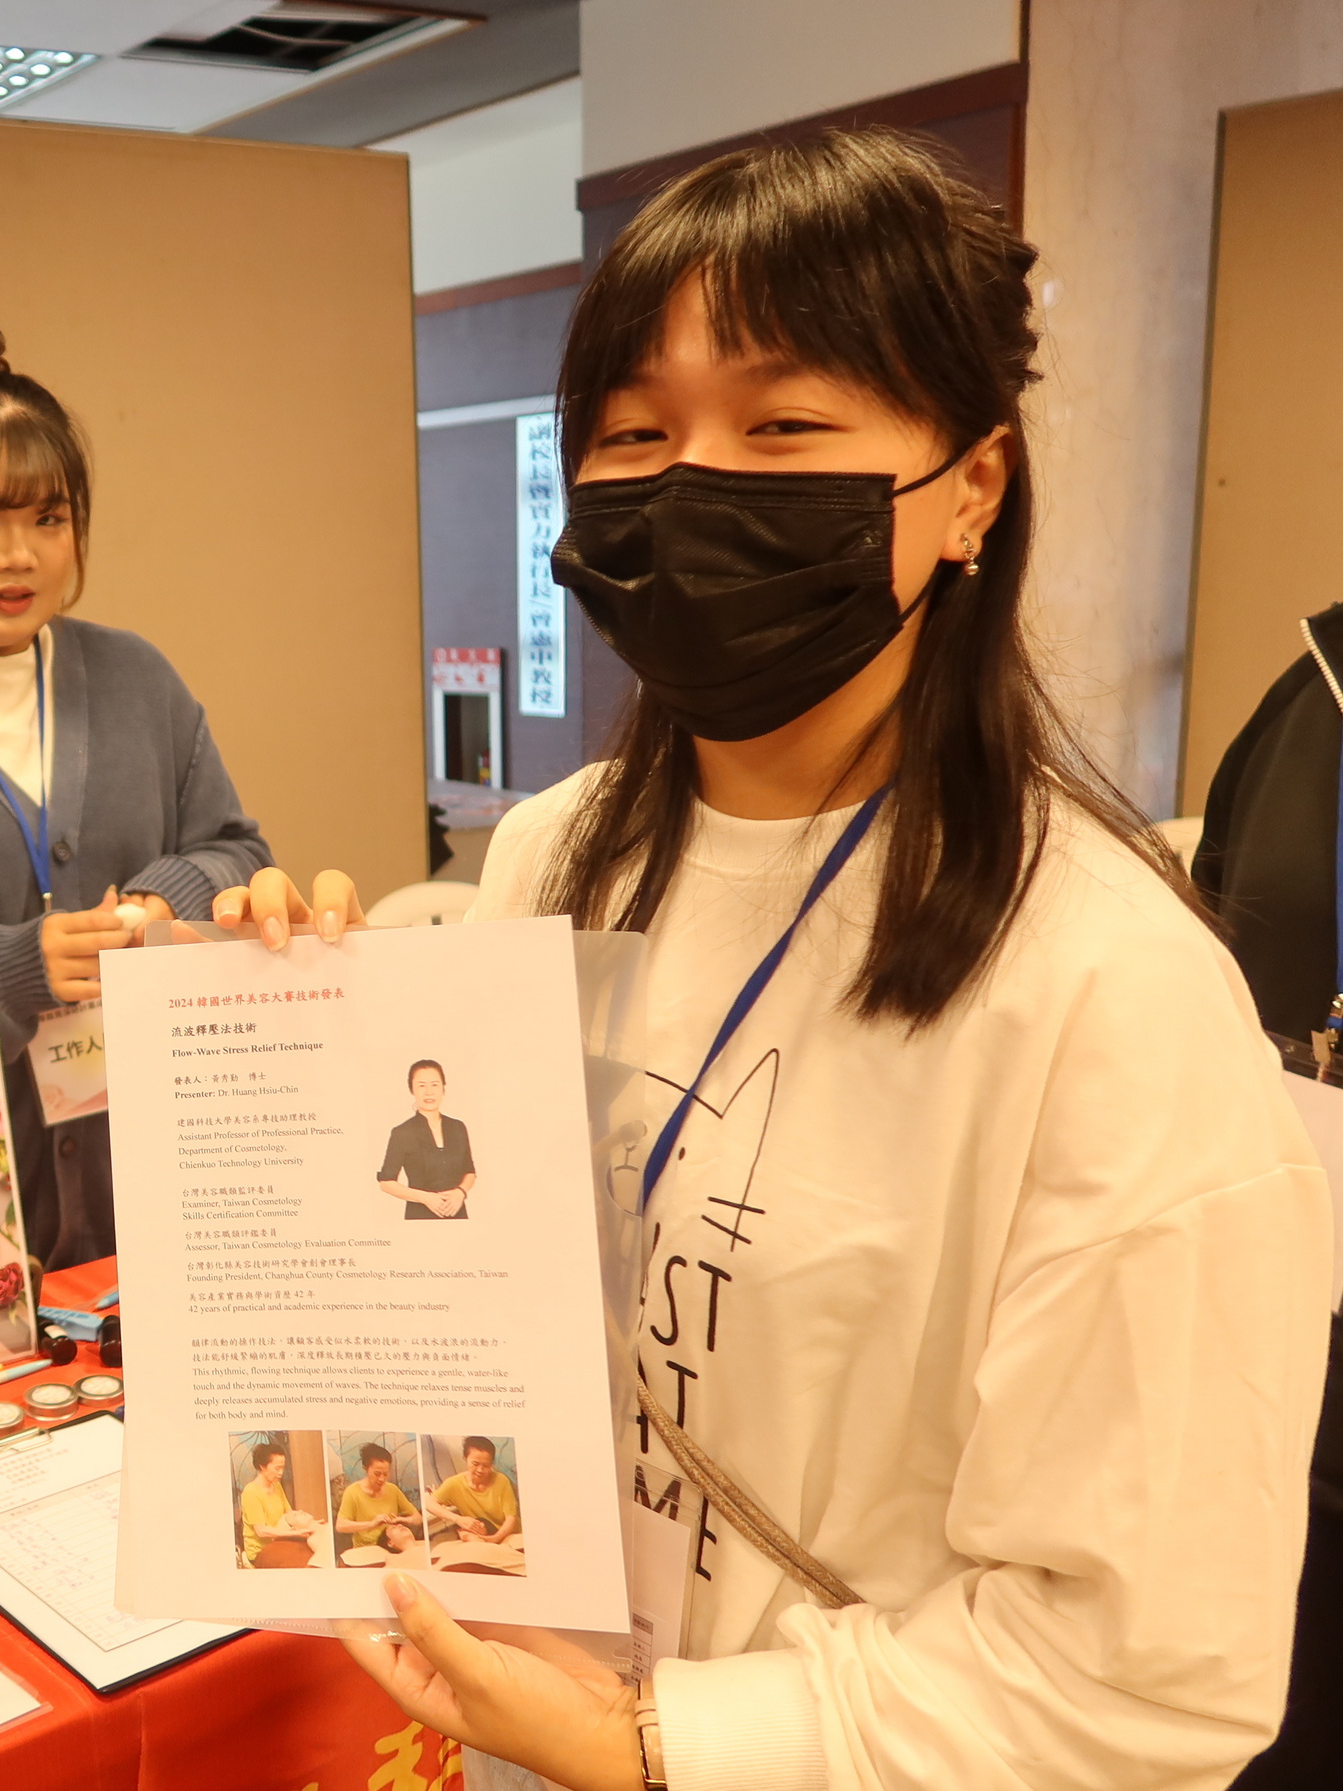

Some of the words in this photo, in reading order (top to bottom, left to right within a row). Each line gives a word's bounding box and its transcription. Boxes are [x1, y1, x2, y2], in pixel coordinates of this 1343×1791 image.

[168, 998, 193, 1008] 2024
[171, 1022, 256, 1036] 流波釋壓法技術
[48, 1034, 104, 1063] 工作人
[172, 1048, 220, 1057] Flow-Wave
[251, 1043, 276, 1052] Relief
[278, 1042, 323, 1051] Technique
[174, 1091, 215, 1099] Presenter:
[217, 1089, 228, 1097] Dr.
[231, 1088, 257, 1097] Huang
[259, 1085, 298, 1094] Hsiu-Chin
[177, 1133, 212, 1141] Assistant
[213, 1130, 249, 1139] Professor
[251, 1129, 259, 1137] of
[261, 1128, 308, 1137] Professional
[310, 1126, 343, 1135] Practice,
[178, 1147, 222, 1156] Department
[224, 1144, 233, 1153] of
[234, 1143, 287, 1153] Cosmetology,
[178, 1160, 216, 1169] Chienkuo
[218, 1159, 261, 1168] Technology
[264, 1157, 303, 1166] University
[223, 1198, 250, 1206] Taiwan
[251, 1197, 302, 1206] Cosmetology
[182, 1212, 204, 1220] Skills
[206, 1210, 254, 1219] Certification
[255, 1209, 298, 1217] Committee
[223, 1242, 250, 1250] Taiwan
[251, 1240, 302, 1249] Cosmetology
[304, 1239, 346, 1247] Evaluation
[347, 1238, 391, 1247] Committee
[186, 1273, 223, 1283] Founding
[265, 1271, 304, 1281] Changhua
[305, 1270, 333, 1280] County
[335, 1270, 386, 1280] Cosmetology
[389, 1269, 425, 1278] Research
[479, 1269, 508, 1278] Taiwan
[294, 1290, 303, 1298] 42
[188, 1305, 198, 1313] 42
[200, 1306, 220, 1314] years
[222, 1303, 230, 1312] of
[232, 1303, 265, 1313] practical
[267, 1303, 282, 1311] and
[283, 1302, 319, 1310] academic
[365, 1302, 373, 1310] in
[375, 1302, 387, 1310] the
[389, 1302, 415, 1312] beauty
[417, 1302, 449, 1312] industry
[192, 1368, 209, 1376] This
[250, 1366, 281, 1376] flowing
[282, 1366, 320, 1375] technique
[322, 1366, 347, 1374] allows
[349, 1366, 375, 1375] clients
[467, 1368, 508, 1377] water-like
[193, 1382, 214, 1390] touch
[216, 1381, 231, 1390] and
[232, 1381, 245, 1390] the
[246, 1381, 279, 1390] dynamic
[324, 1380, 333, 1388] of
[364, 1381, 378, 1389] The
[380, 1382, 419, 1392] technique
[420, 1383, 449, 1391] relaxes
[474, 1384, 507, 1392] muscles
[509, 1384, 524, 1393] and
[193, 1396, 219, 1406] deeply
[221, 1396, 253, 1404] releases
[254, 1395, 303, 1404] accumulated
[328, 1395, 343, 1403] and
[345, 1397, 378, 1405] negative
[420, 1398, 459, 1408] providing
[491, 1399, 501, 1407] of
[502, 1399, 525, 1408] relief
[195, 1411, 206, 1419] for
[208, 1411, 226, 1419] both
[227, 1410, 246, 1419] body
[249, 1410, 263, 1418] and
